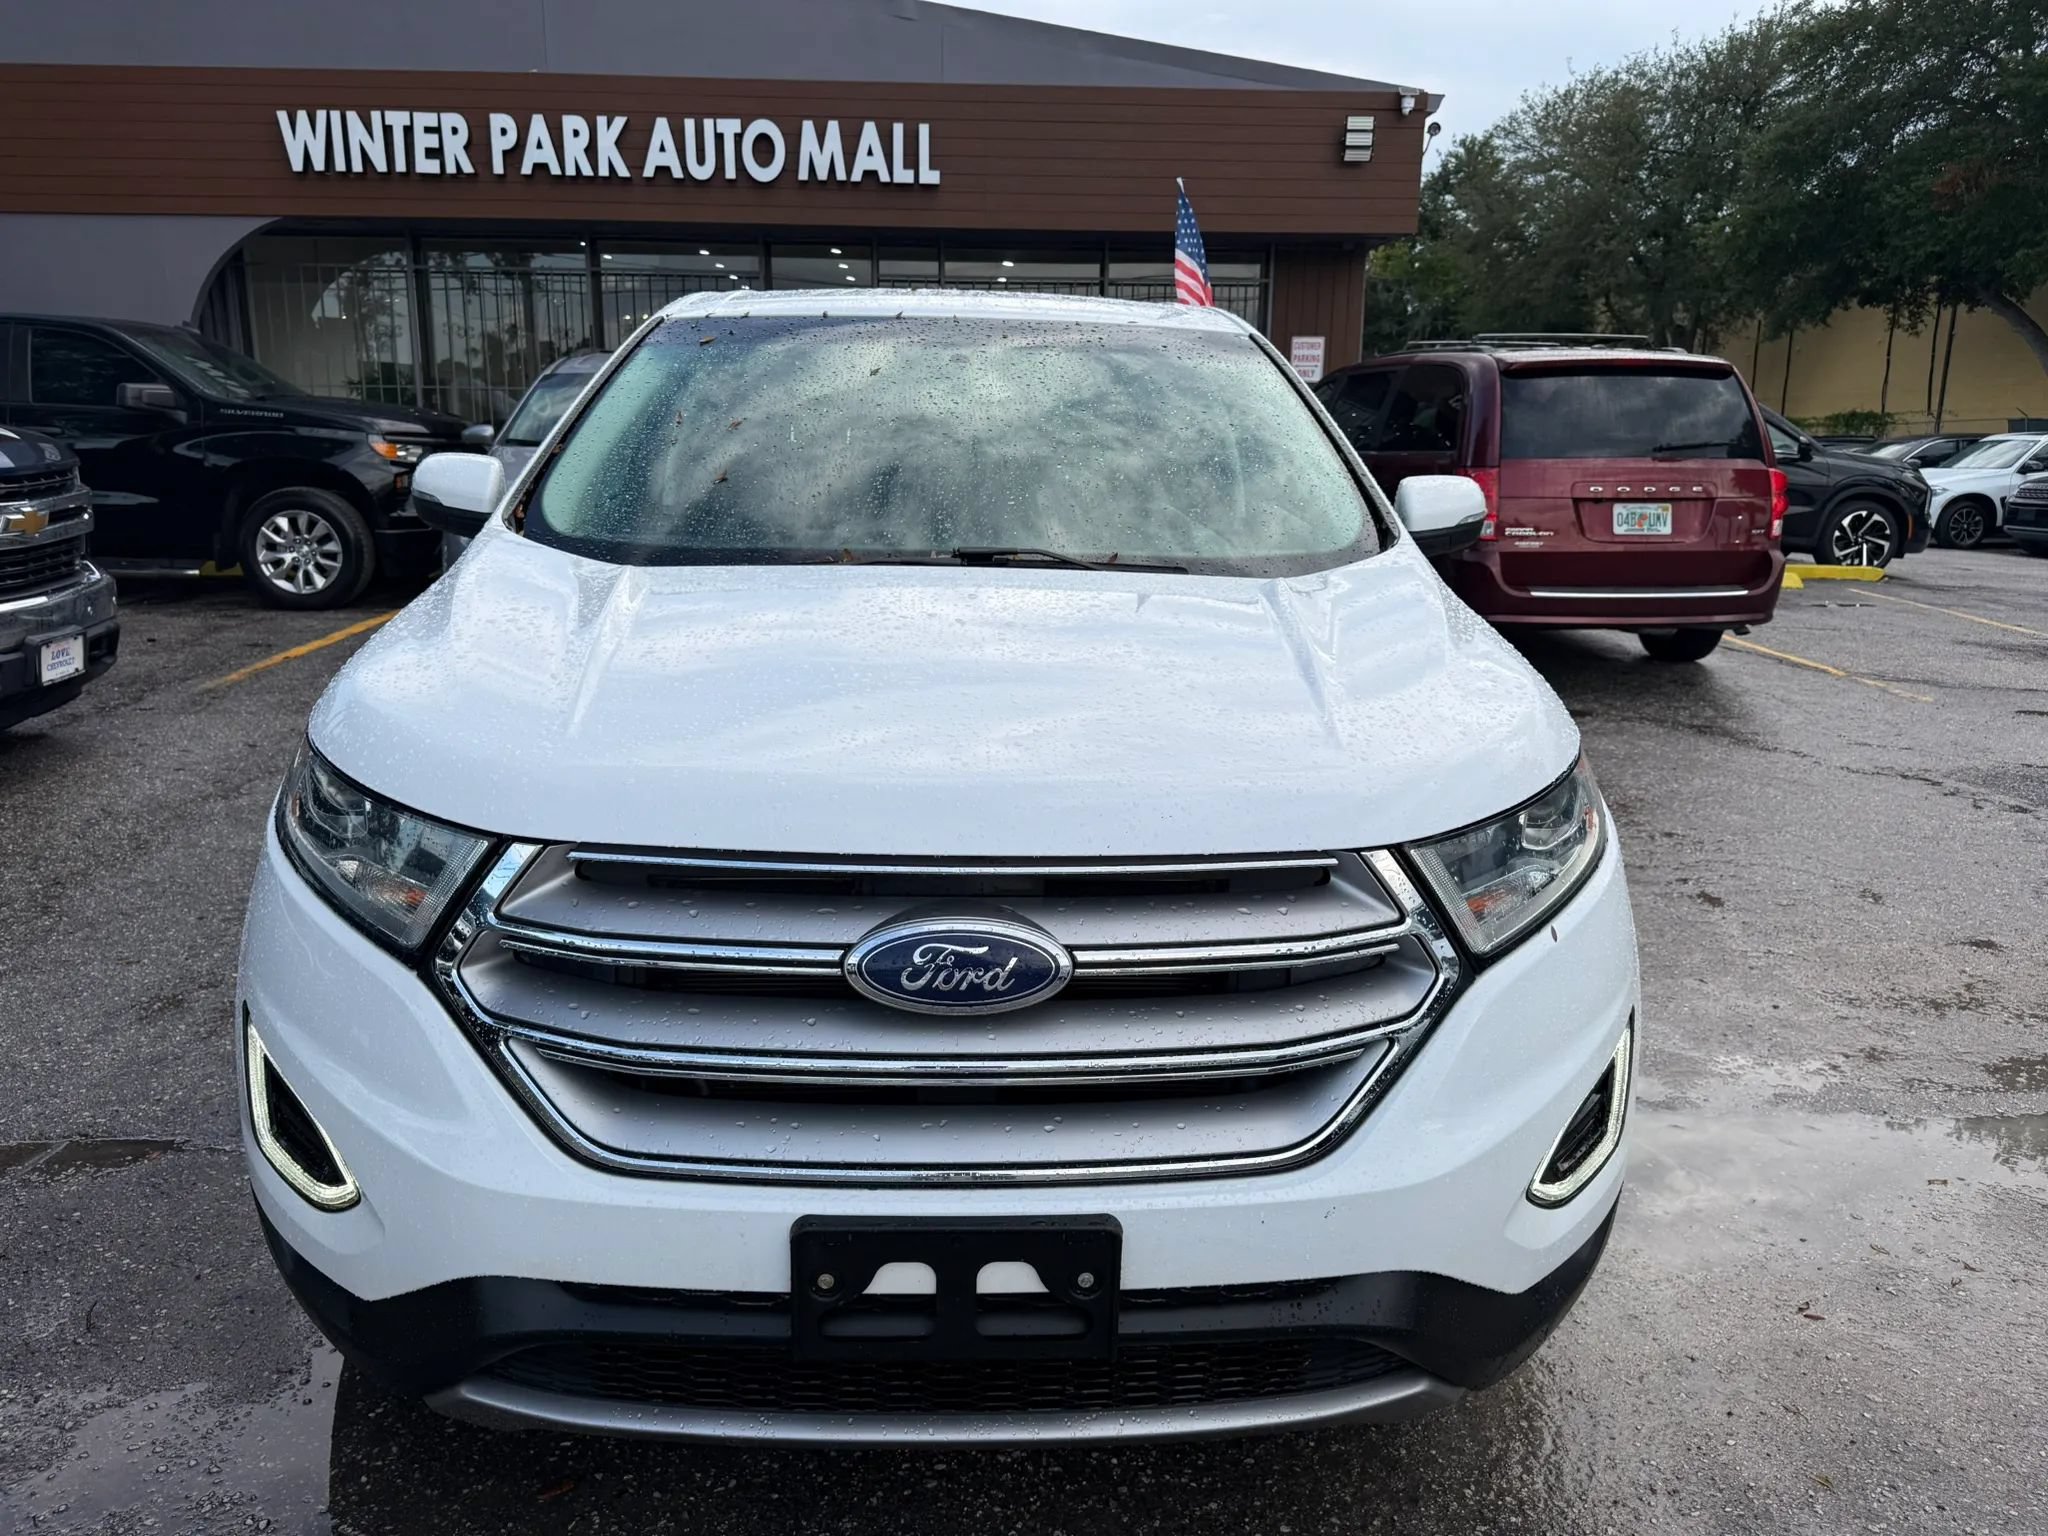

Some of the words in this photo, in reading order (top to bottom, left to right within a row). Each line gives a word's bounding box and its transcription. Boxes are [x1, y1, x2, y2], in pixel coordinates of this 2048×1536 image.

[275, 109, 475, 175] WINTER
[488, 112, 631, 178] PARK
[642, 116, 786, 183] AUTO
[797, 119, 941, 185] MALL
[1293, 341, 1321, 351] CUSTOMER
[1293, 354, 1321, 363] PARKING
[1589, 485, 1704, 493] DODGE
[51, 647, 71, 660] LOVE
[900, 943, 1018, 991] Ford
